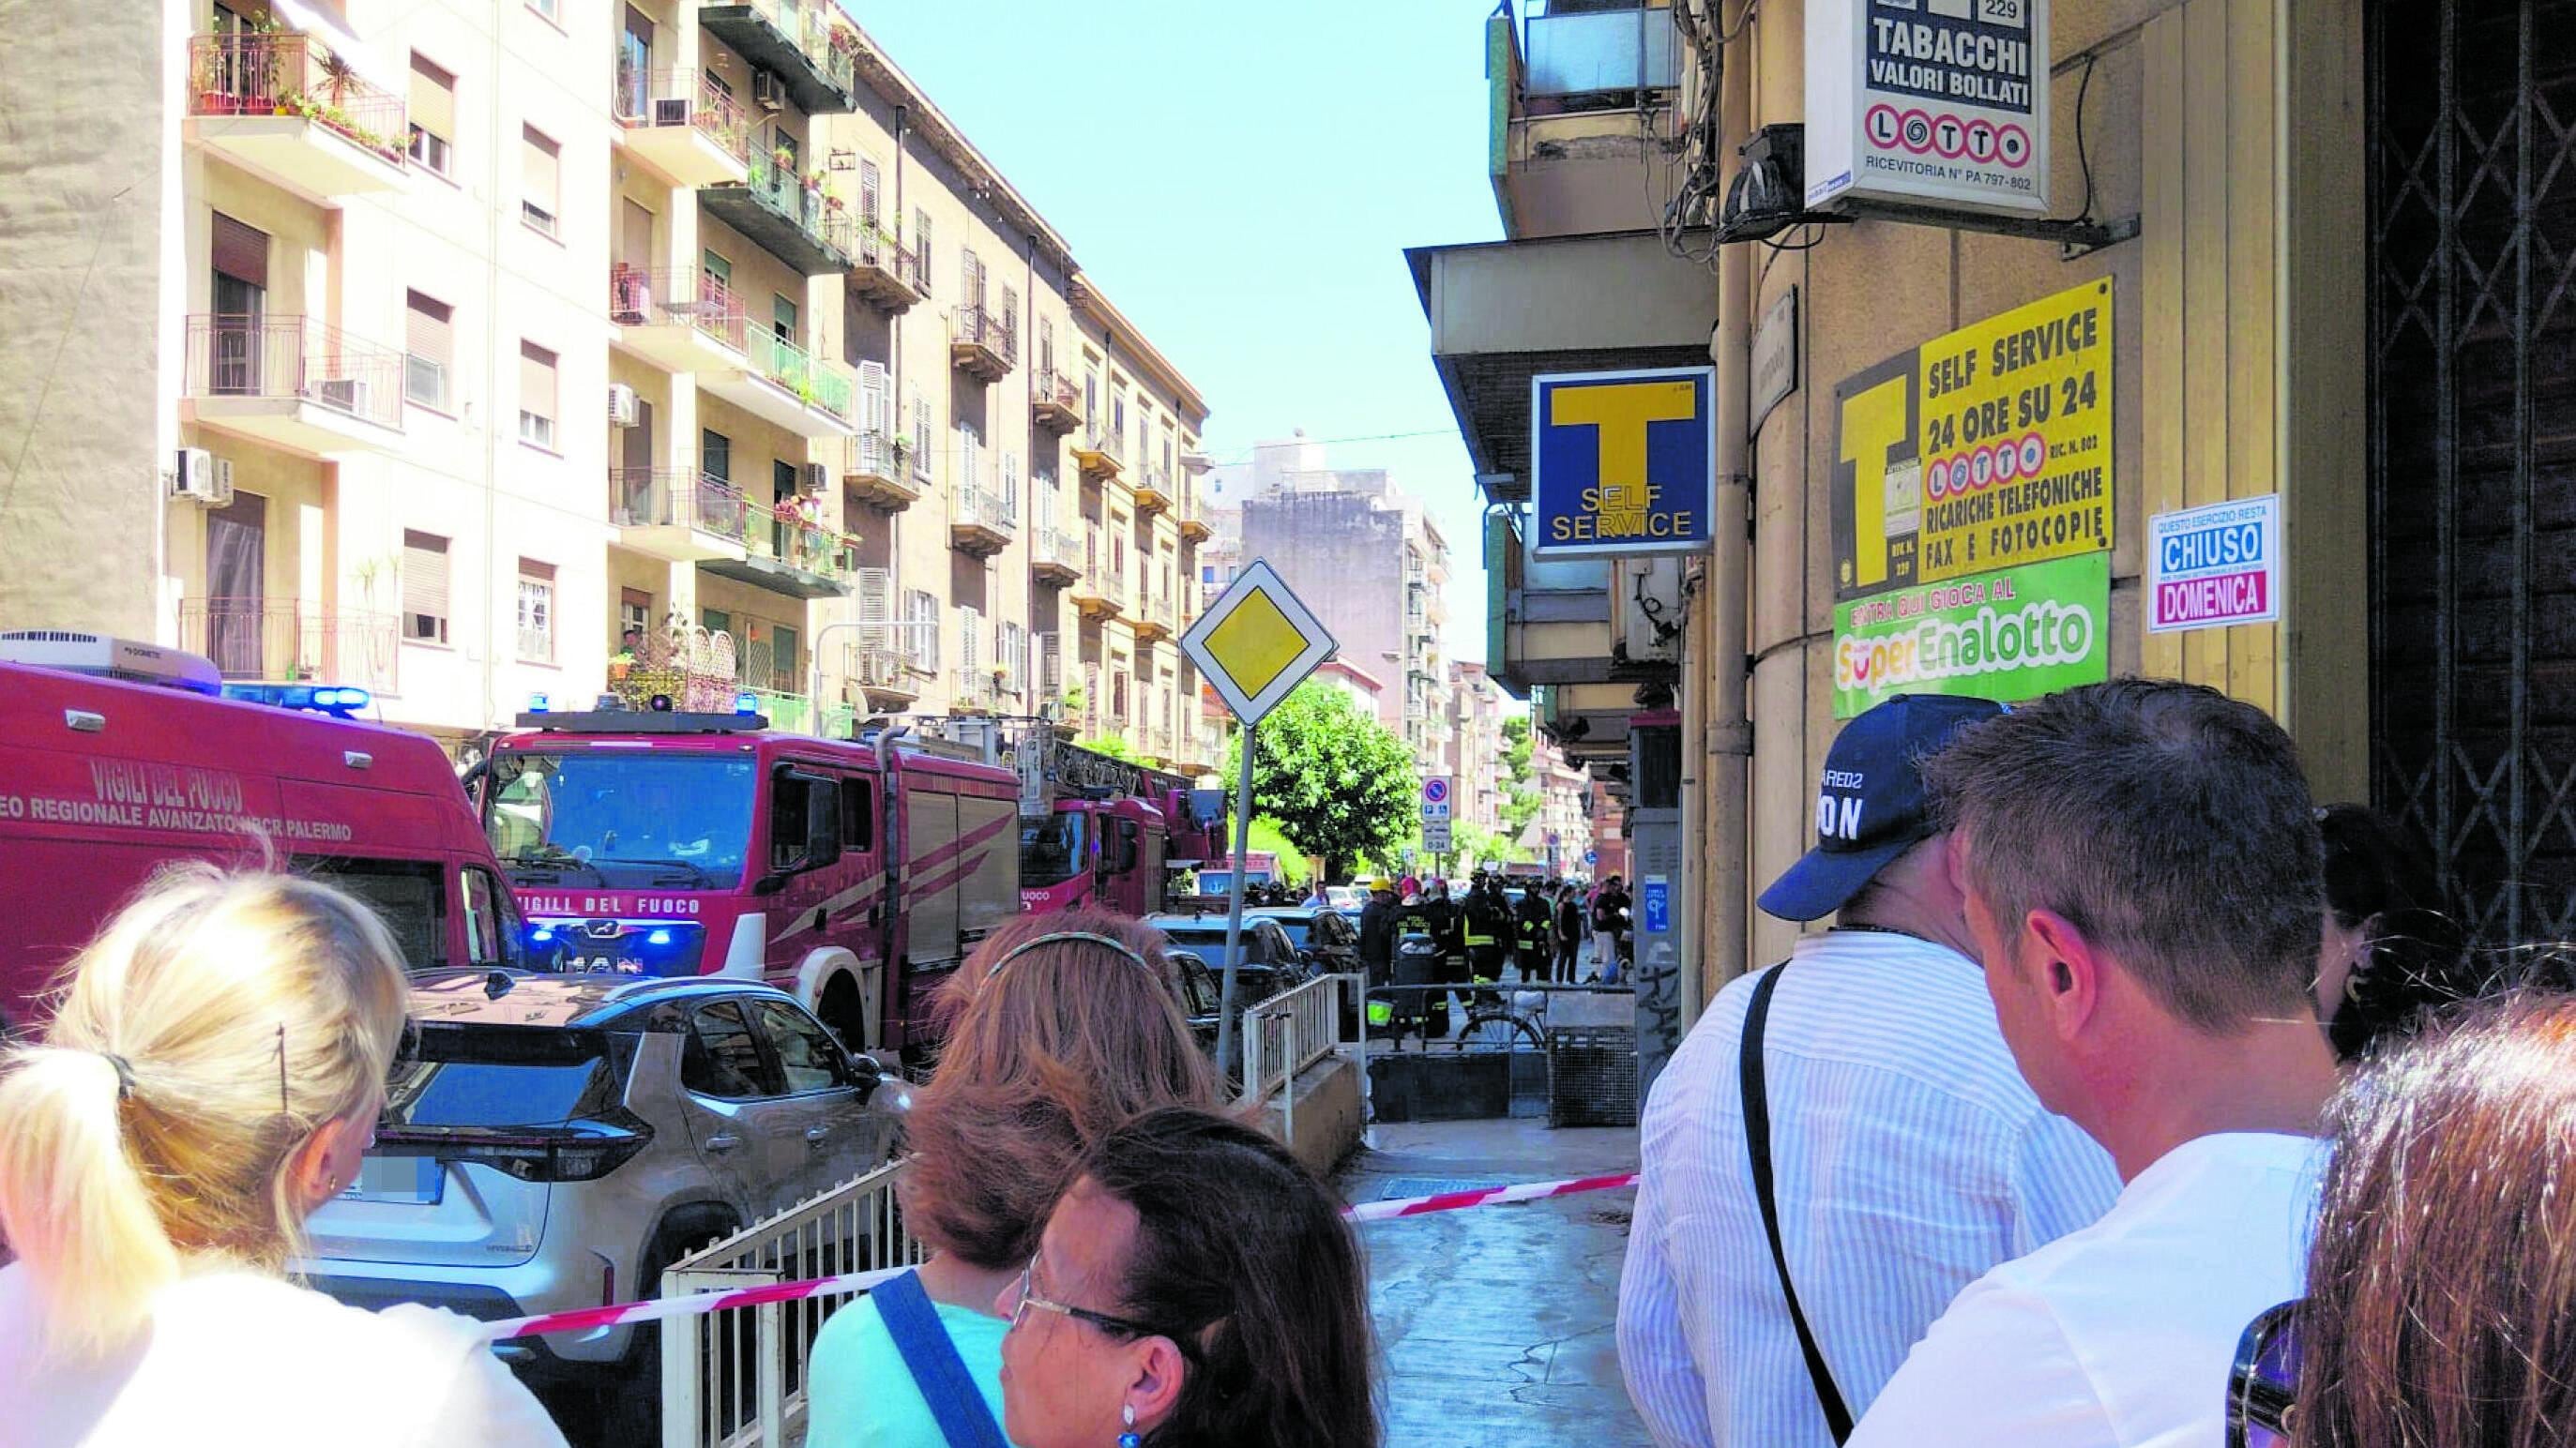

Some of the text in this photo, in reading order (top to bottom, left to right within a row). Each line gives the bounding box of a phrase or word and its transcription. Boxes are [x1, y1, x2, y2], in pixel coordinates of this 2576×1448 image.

[1985, 0, 2018, 19] 229
[1872, 16, 2027, 77] TABACCHI
[1871, 58, 2029, 105] VALORI BOLLATI
[1867, 105, 2029, 167] LOTTO
[1866, 156, 1946, 179] RICEVITORIA
[1966, 170, 1981, 183] PA
[1985, 173, 2031, 190] 797-802
[1929, 308, 2097, 399] SELF SERVICE
[1929, 370, 2097, 455] 24 ORE SU 24
[1552, 381, 1695, 535] T
[1929, 432, 2045, 501] LOTTO
[1581, 485, 1662, 512] SELF
[1927, 466, 2102, 535] RICARICHE TELEFONICHE
[2239, 505, 2267, 520] RESTA
[1553, 511, 1692, 541] SERVICE
[1927, 506, 2102, 570] FAX E FOTOCOPIE
[2165, 524, 2259, 572] CHIUSO
[1851, 577, 2016, 627] ENTRA QUI GIOCA AL
[2163, 574, 2259, 621] DOMENICA
[90, 757, 244, 813] VIGILI DEL FUOCO
[30, 797, 143, 826] REGIONALE
[148, 807, 234, 833] AVANZATO
[286, 819, 352, 841] PALERMO
[585, 897, 622, 913] DEL
[638, 897, 700, 913] FUOCO
[1022, 891, 1051, 901] UOCO
